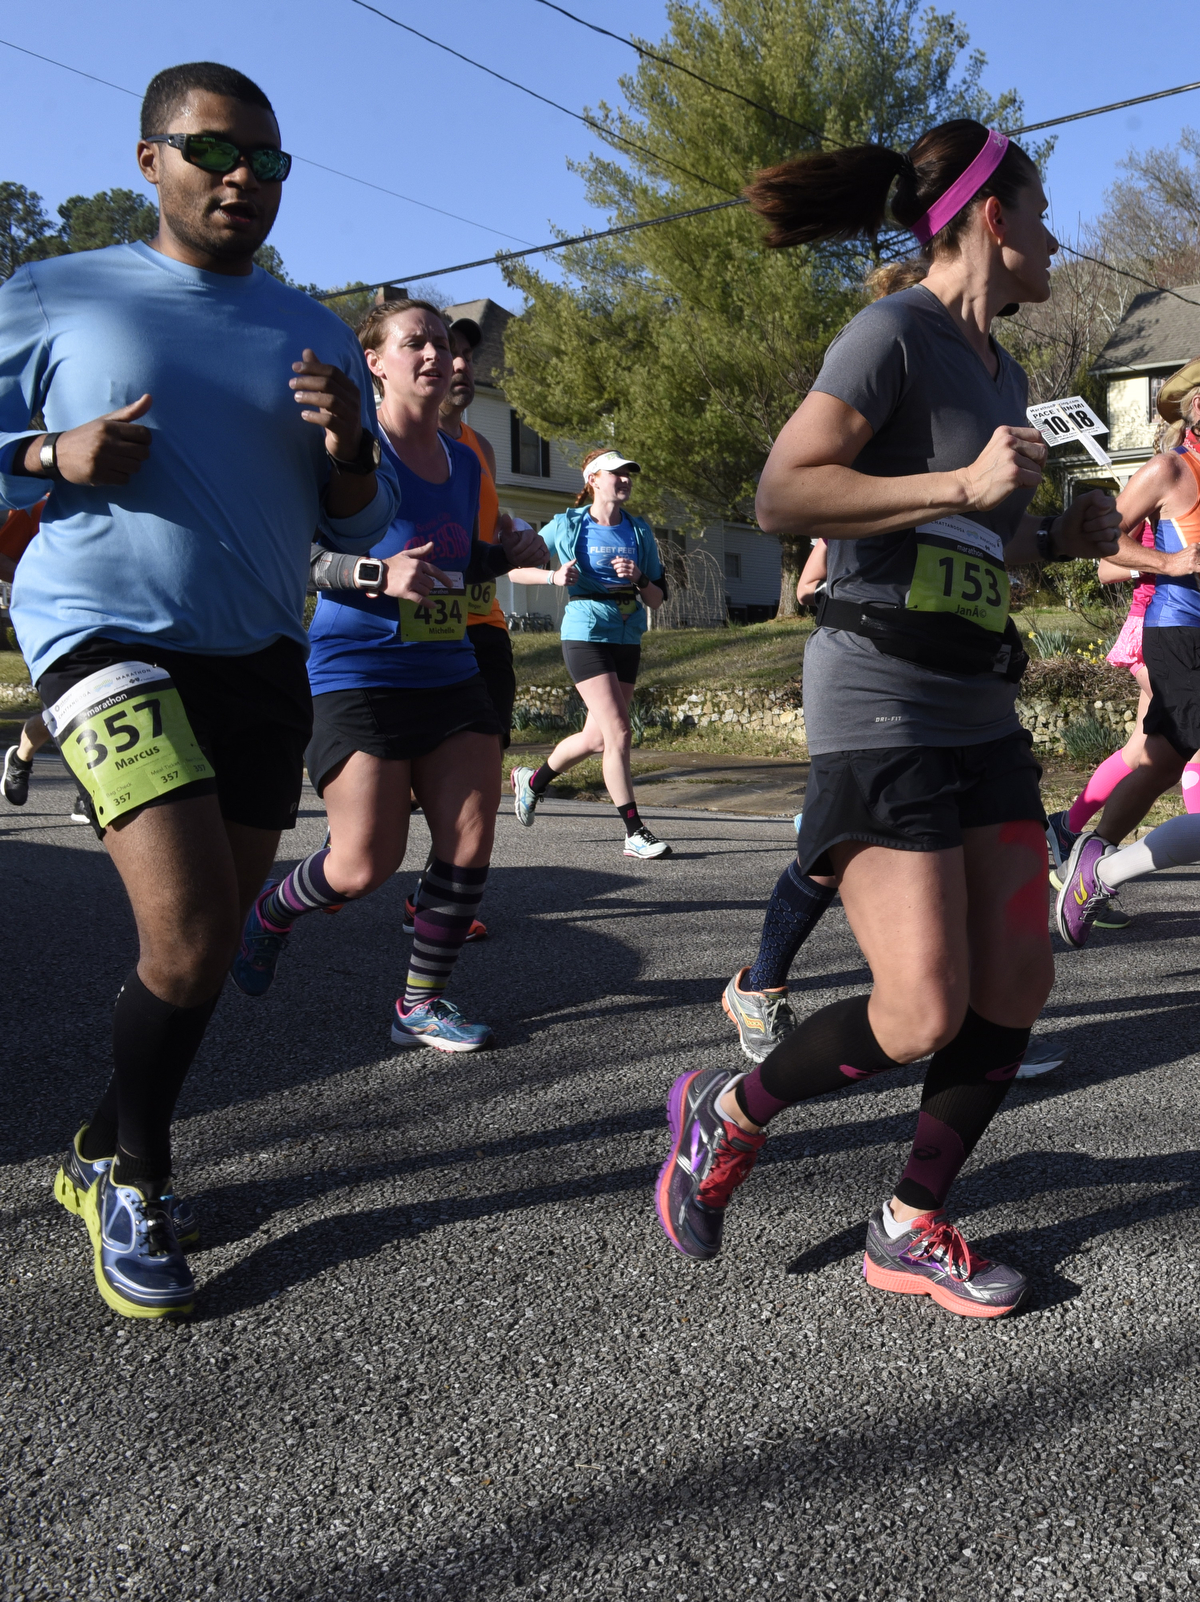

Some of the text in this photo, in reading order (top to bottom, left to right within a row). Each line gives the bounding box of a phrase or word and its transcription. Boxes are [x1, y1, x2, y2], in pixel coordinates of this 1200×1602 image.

[1032, 409, 1056, 419] PACE
[1043, 410, 1095, 436] 10:18
[590, 546, 636, 554] FLEET FEET
[956, 544, 985, 559] marathon
[939, 556, 1002, 607] 153
[413, 599, 463, 625] 434
[428, 627, 455, 635] Michelle
[115, 668, 152, 681] MARATHON
[86, 693, 129, 718] marathon
[875, 715, 902, 723] DRI-FIT
[75, 698, 163, 771] 357
[114, 745, 161, 771] Marcus
[150, 760, 181, 777] Meal Ticket
[193, 763, 206, 773] 357
[160, 770, 180, 784] 357
[116, 782, 132, 793] Check
[112, 792, 132, 807] 357
